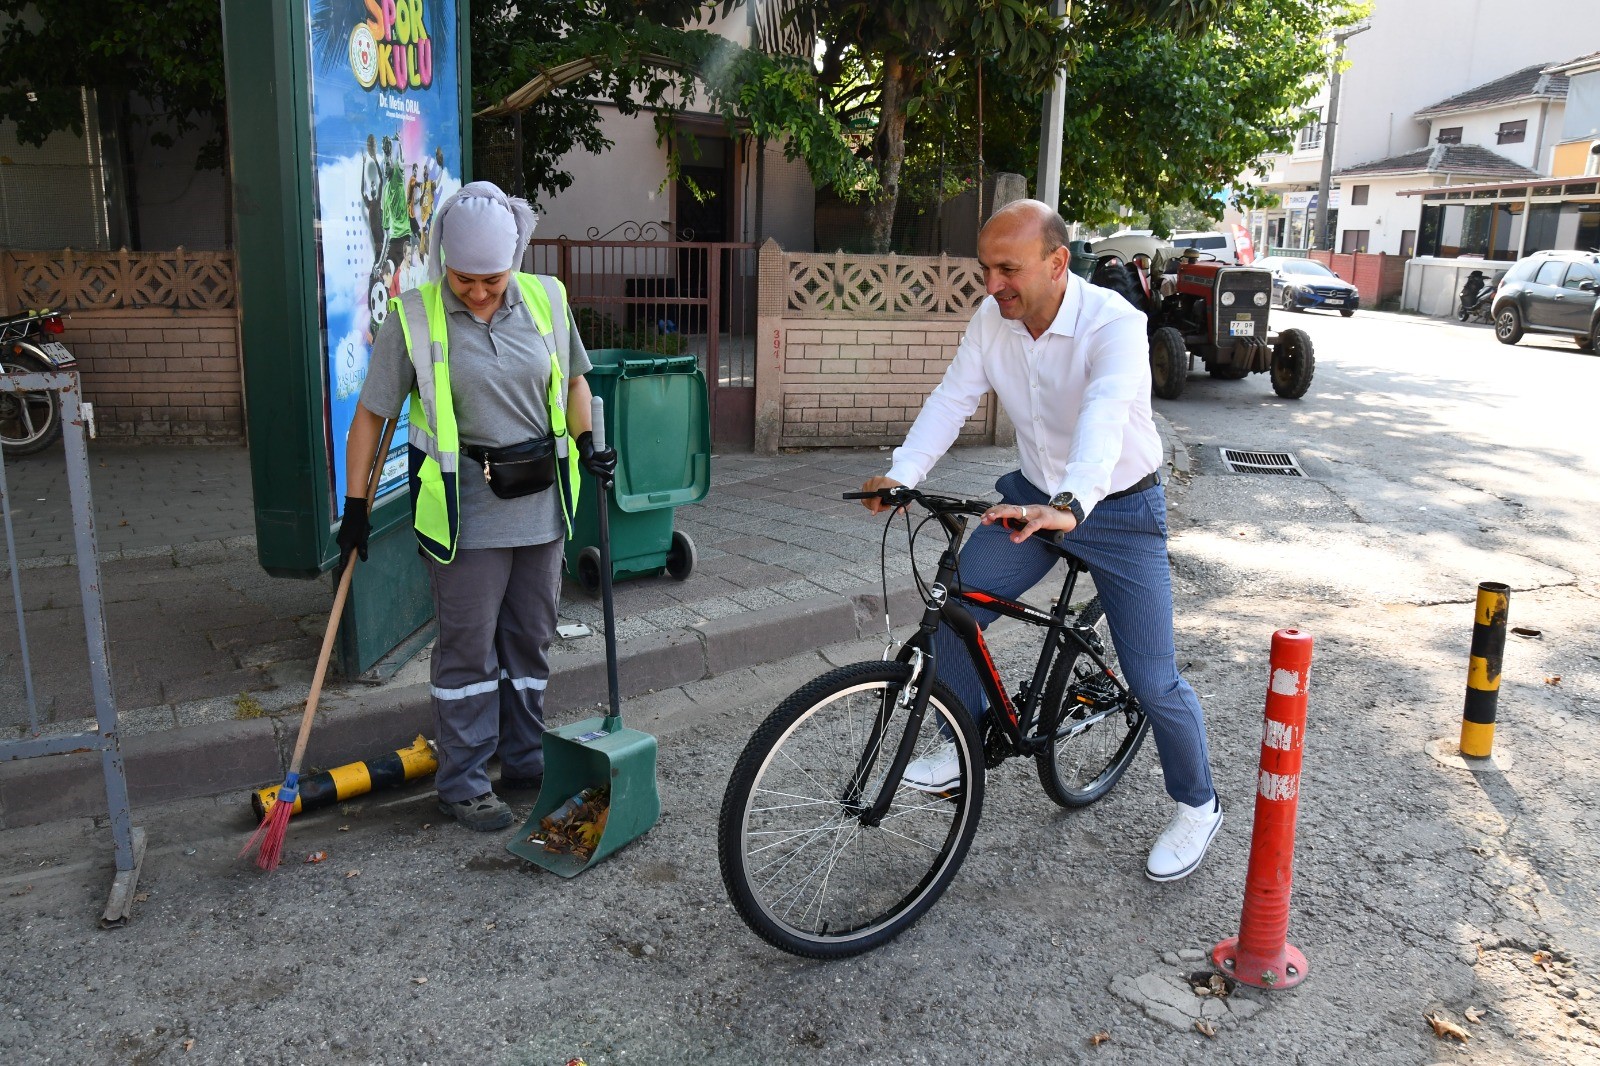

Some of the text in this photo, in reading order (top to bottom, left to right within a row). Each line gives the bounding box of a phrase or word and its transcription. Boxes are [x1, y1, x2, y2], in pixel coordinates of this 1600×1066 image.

[364, 0, 427, 44] SPOR
[405, 99, 420, 114] ORAL
[346, 342, 355, 368] 8
